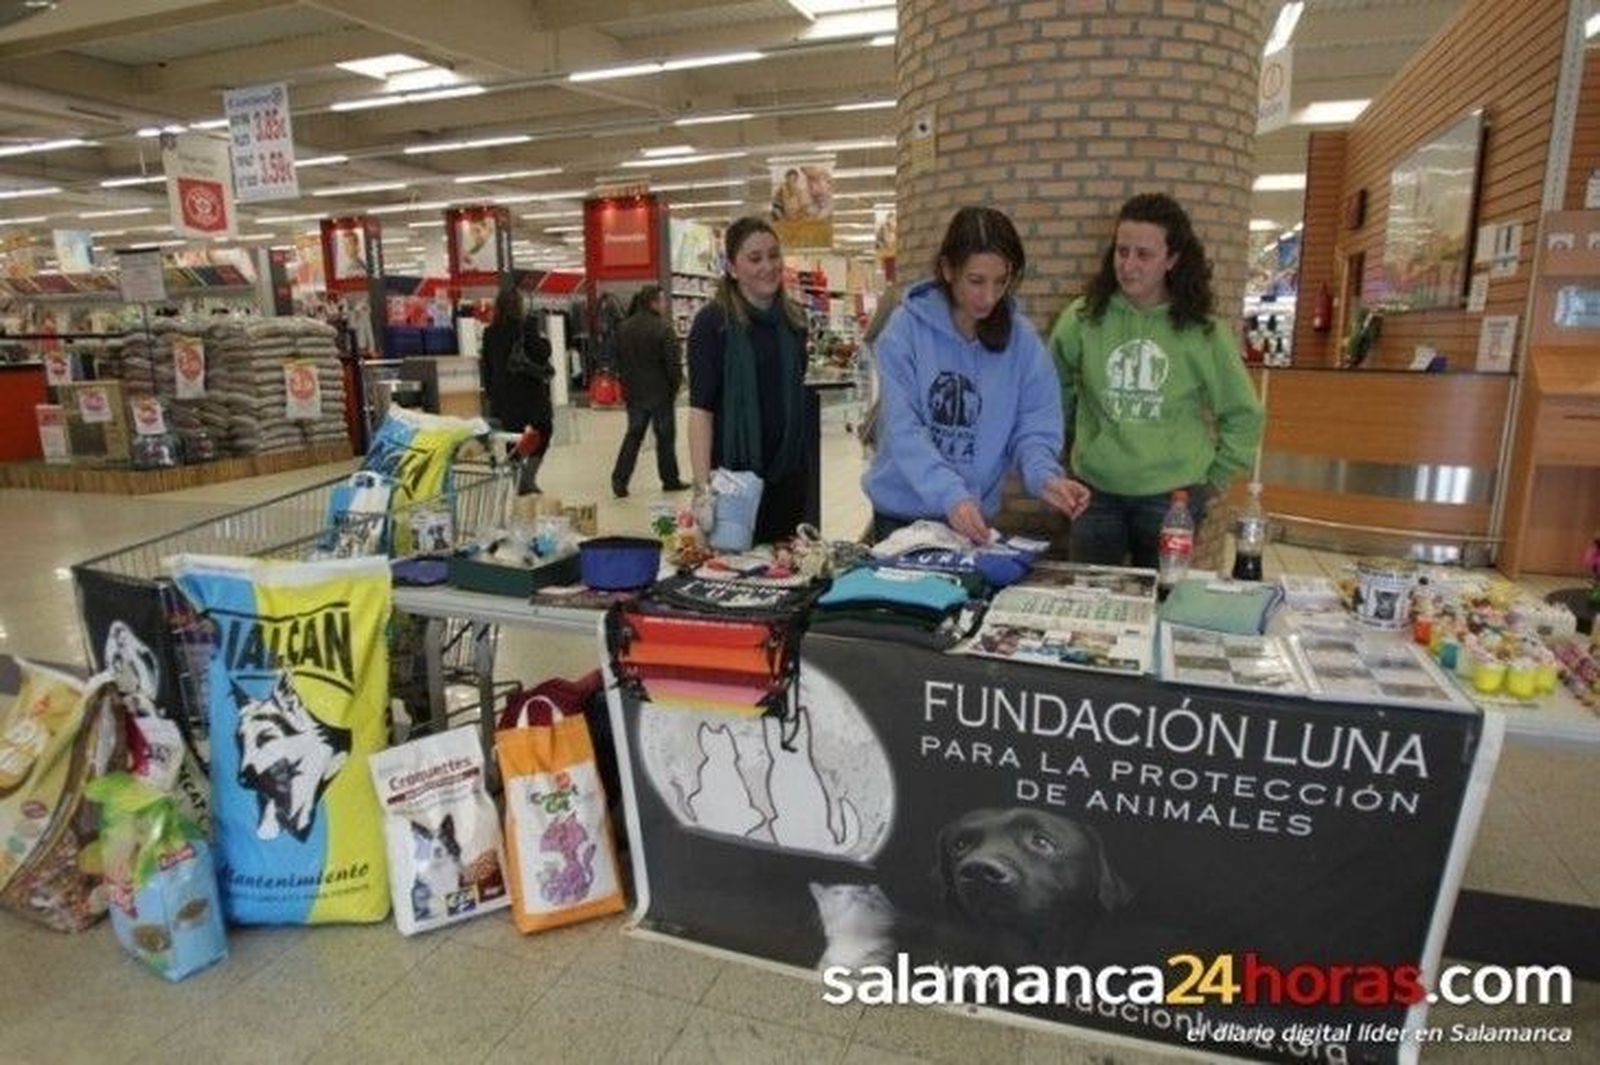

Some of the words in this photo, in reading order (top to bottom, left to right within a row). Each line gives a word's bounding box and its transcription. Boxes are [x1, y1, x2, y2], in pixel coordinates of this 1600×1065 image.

[924, 680, 1250, 760] FUNDACIÓN
[1263, 718, 1429, 779] LUNA
[920, 735, 1021, 769] PARA
[1040, 751, 1091, 779] LA
[1111, 760, 1420, 815] PROTECCIÓN
[1016, 778, 1068, 806] DE
[1086, 789, 1313, 837] ANIMALES
